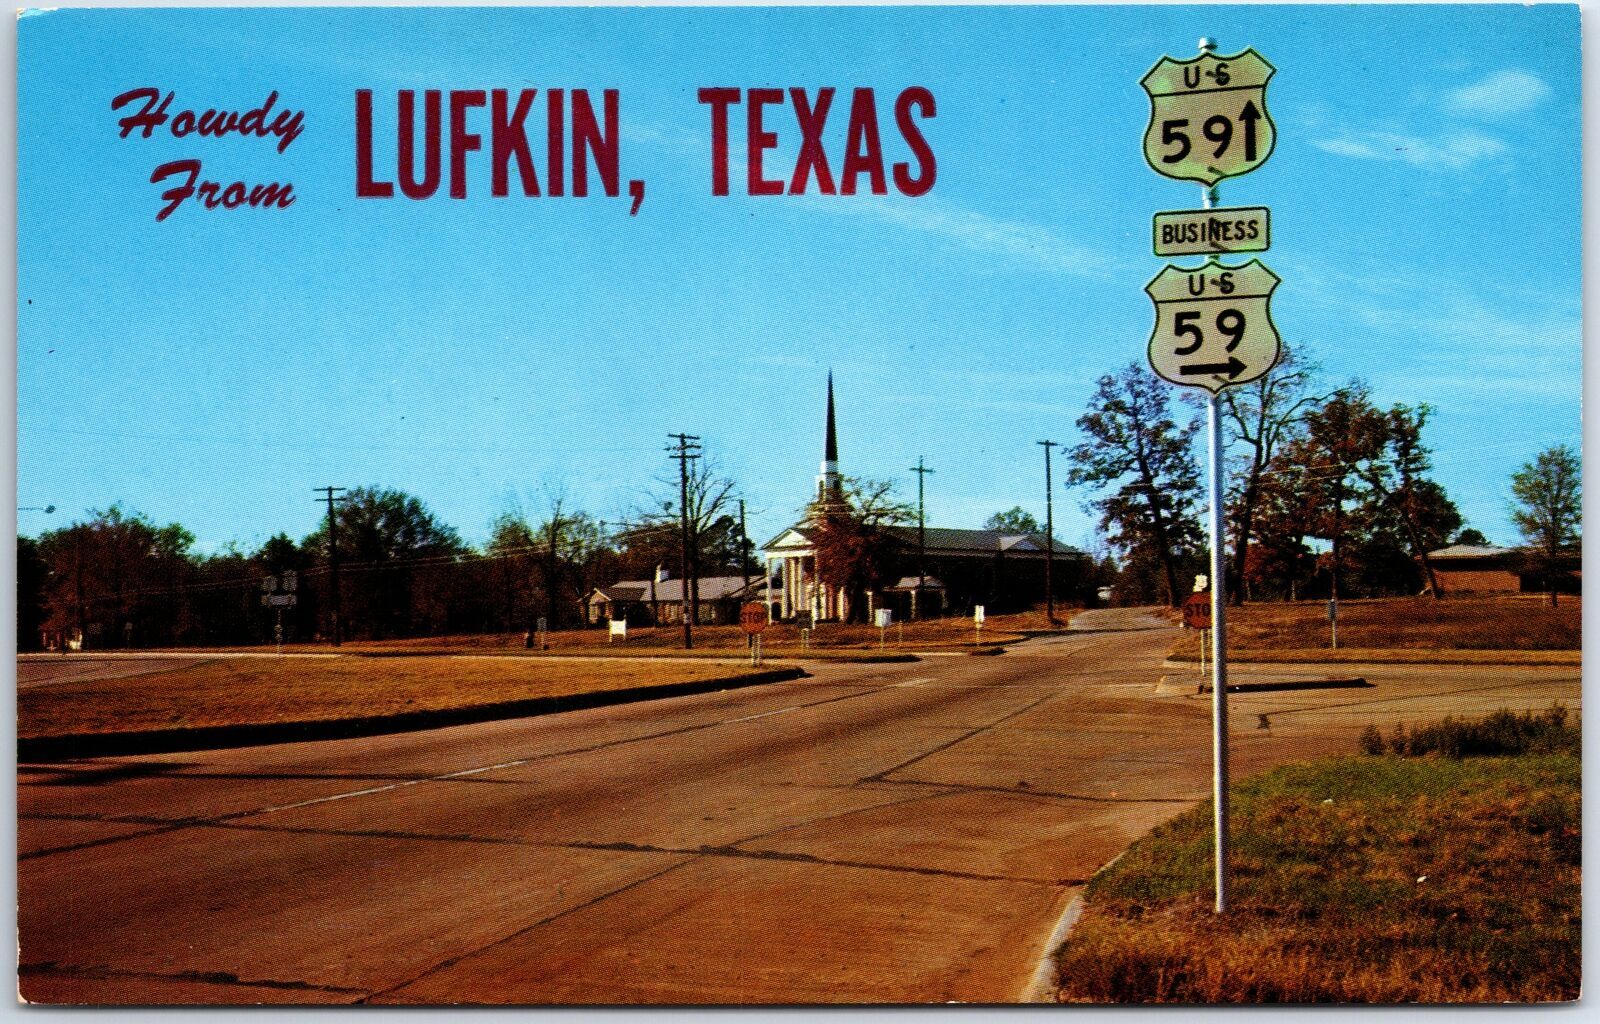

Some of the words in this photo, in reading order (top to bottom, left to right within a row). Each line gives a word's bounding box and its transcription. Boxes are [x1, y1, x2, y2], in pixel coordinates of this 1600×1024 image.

[1162, 114, 1234, 164] 59
[1161, 219, 1260, 245] BUSINESS
[1173, 308, 1247, 357] 59
[1185, 603, 1211, 618] STO
